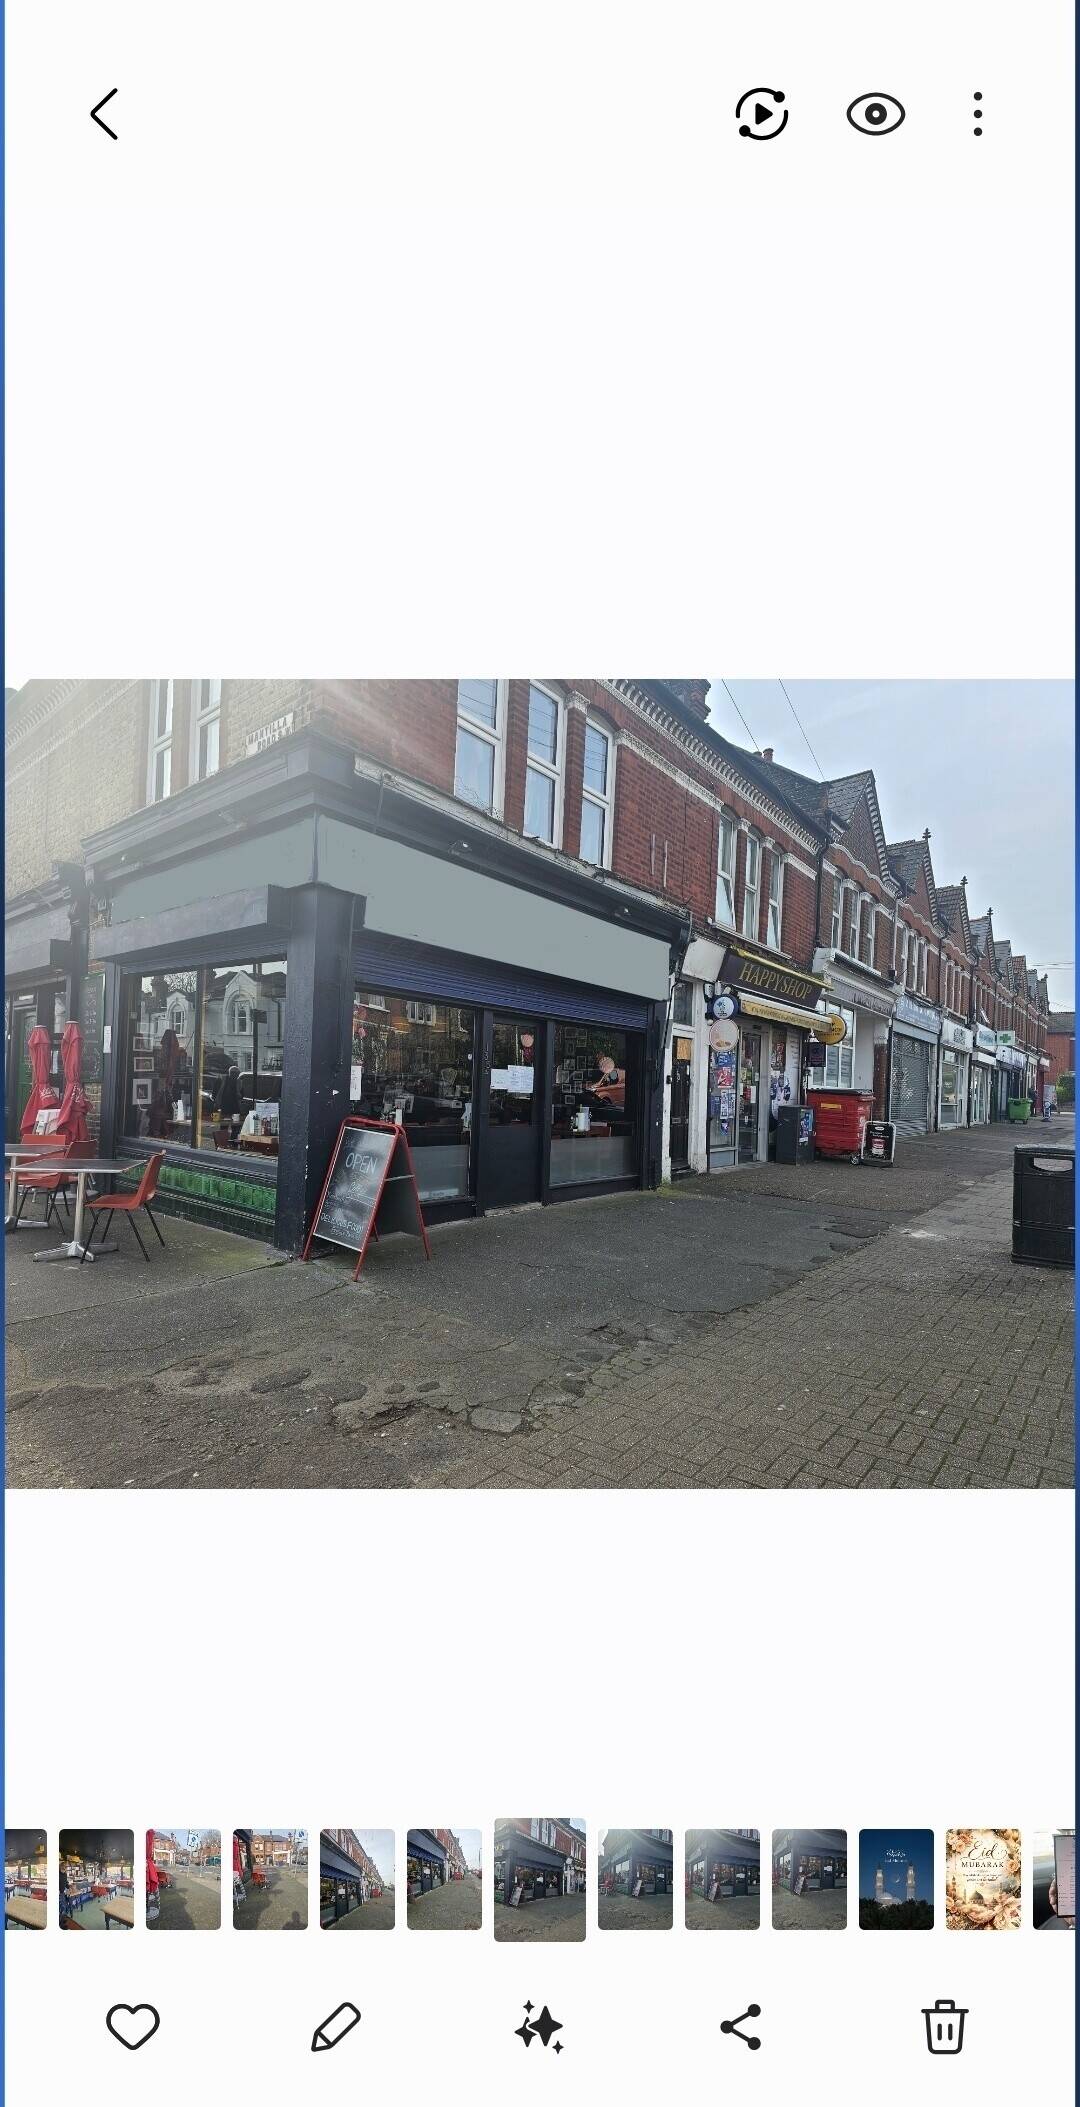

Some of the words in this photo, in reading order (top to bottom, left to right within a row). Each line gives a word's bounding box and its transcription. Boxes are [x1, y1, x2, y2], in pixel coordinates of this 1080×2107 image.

[739, 962, 812, 999] HAPPYSHOP
[345, 1152, 378, 1174] OPEN
[961, 1841, 1007, 1860] Eid
